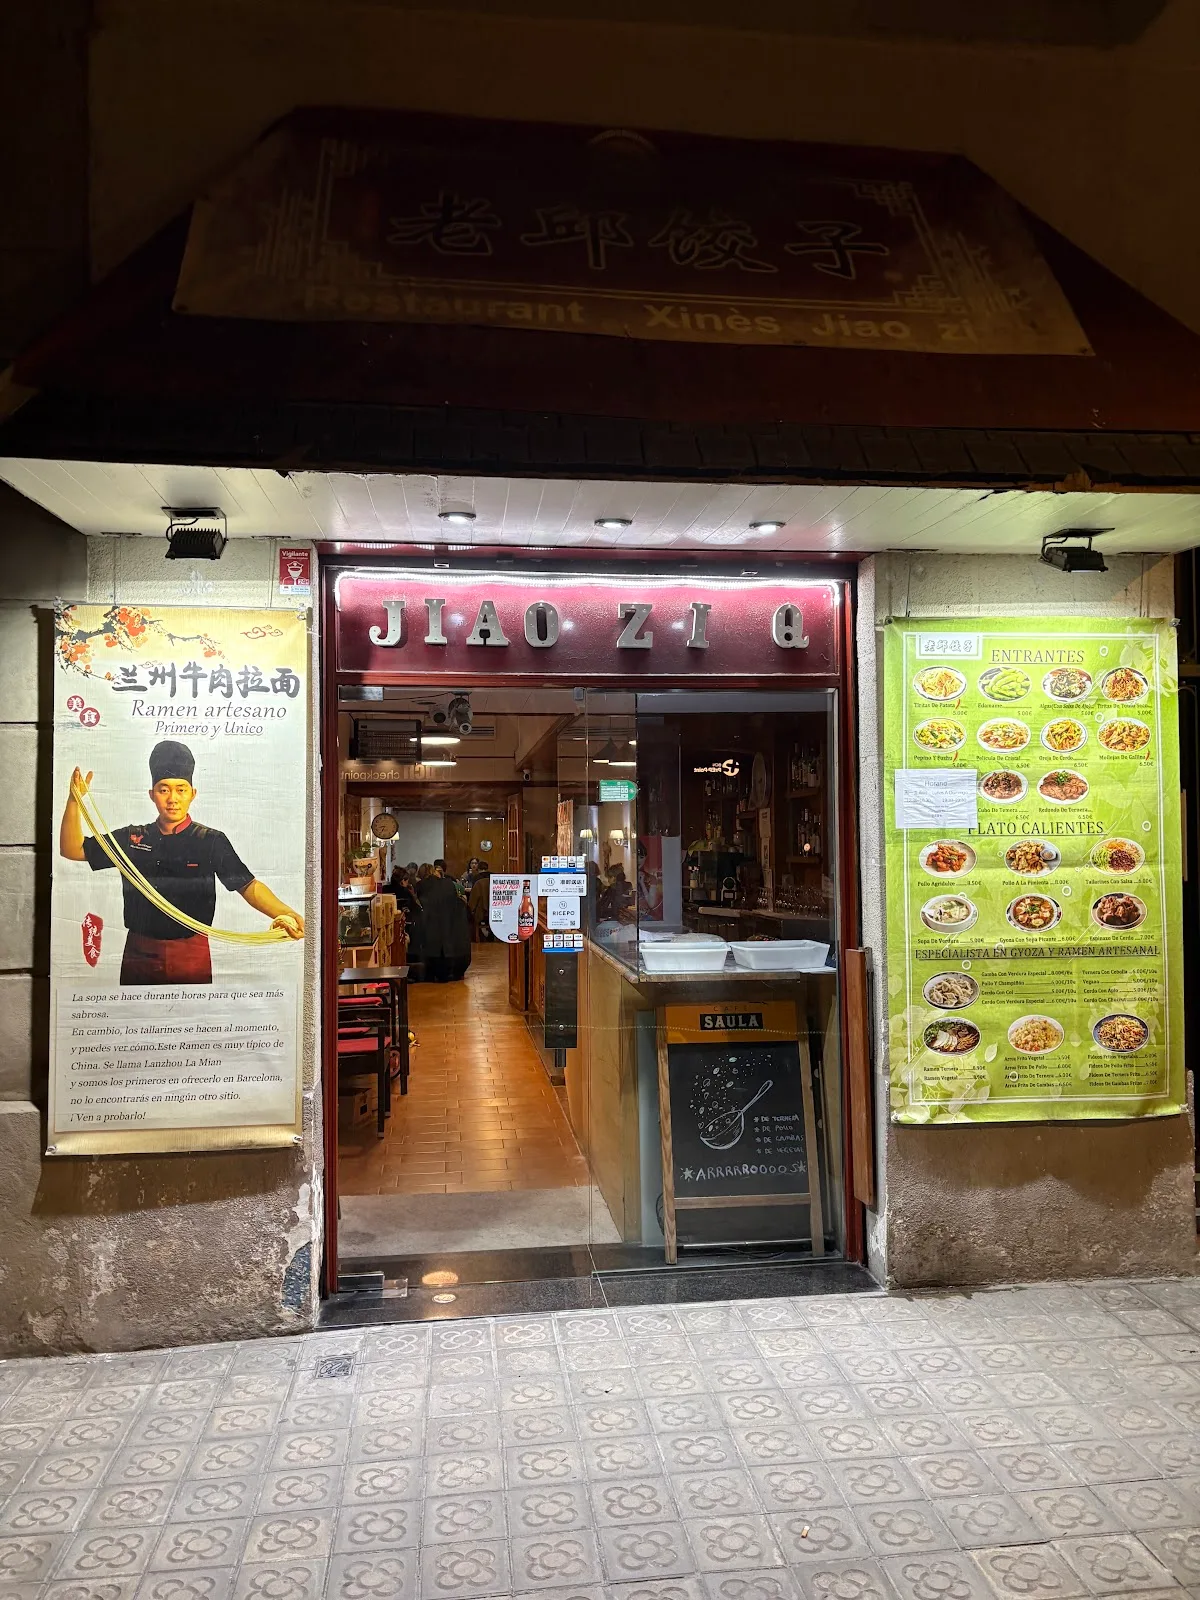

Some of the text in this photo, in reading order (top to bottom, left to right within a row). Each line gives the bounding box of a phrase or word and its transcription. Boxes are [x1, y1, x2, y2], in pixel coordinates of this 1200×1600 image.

[302, 288, 587, 325] Restaurant
[645, 302, 781, 337] Xinès
[813, 313, 911, 342] Jiao
[369, 598, 810, 649] JIAO ZI Q
[991, 649, 1085, 663] ENTRANTES
[111, 661, 301, 698] 兰州牛肉拉面
[132, 699, 287, 719] Ramen artesano
[155, 721, 264, 738] Primero y Unico
[1021, 821, 1104, 834] CALIENTES
[915, 945, 1161, 959] ESPECIALISTA EN GYOZA Y RAMEN ARTESANAL
[72, 993, 83, 1002] La
[85, 993, 107, 1004] sopa
[120, 991, 142, 1001] hace
[143, 990, 180, 1001] durante
[181, 990, 207, 1000] horas
[207, 991, 229, 1001] para
[230, 990, 247, 1001] que
[248, 990, 264, 998] sea
[265, 989, 284, 998] más
[71, 1009, 110, 1019] sabrosa.
[704, 1015, 759, 1028] SAULA
[71, 1023, 279, 1037] En cambio, los tallarines se hacen al momento,
[71, 1045, 78, 1055] y
[78, 1043, 111, 1055] puedes
[129, 1042, 177, 1052] cómo.Este
[178, 1042, 211, 1050] Ramen
[224, 1042, 245, 1052] muy
[245, 1039, 271, 1050] típico
[272, 1039, 285, 1048] de
[70, 1057, 222, 1071] China. Se llama Lanzhou La Mian
[69, 1081, 77, 1090] y
[78, 1078, 108, 1087] somos
[109, 1077, 123, 1086] los
[125, 1076, 167, 1088] primeros
[181, 1074, 222, 1085] ofrecerlo
[236, 1073, 283, 1084] Barcelona,
[70, 1091, 241, 1105] no lo encontrarás en ningún otro sitio.
